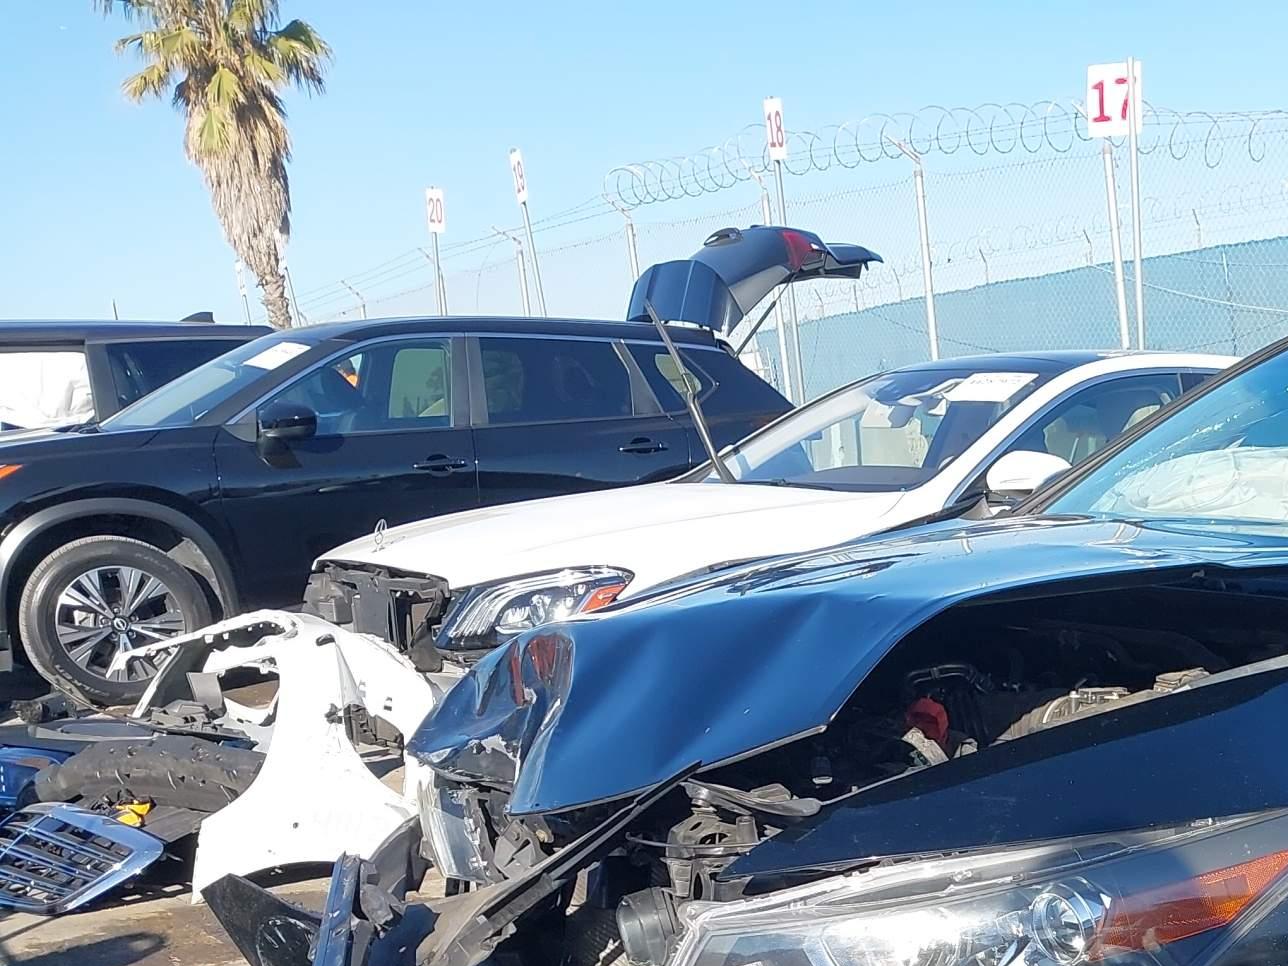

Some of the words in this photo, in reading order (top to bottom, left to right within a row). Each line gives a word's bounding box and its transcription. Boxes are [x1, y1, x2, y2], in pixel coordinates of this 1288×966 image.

[1091, 77, 1129, 123] 17
[767, 110, 784, 148] 18
[511, 160, 525, 194] 19
[428, 197, 443, 224] 20
